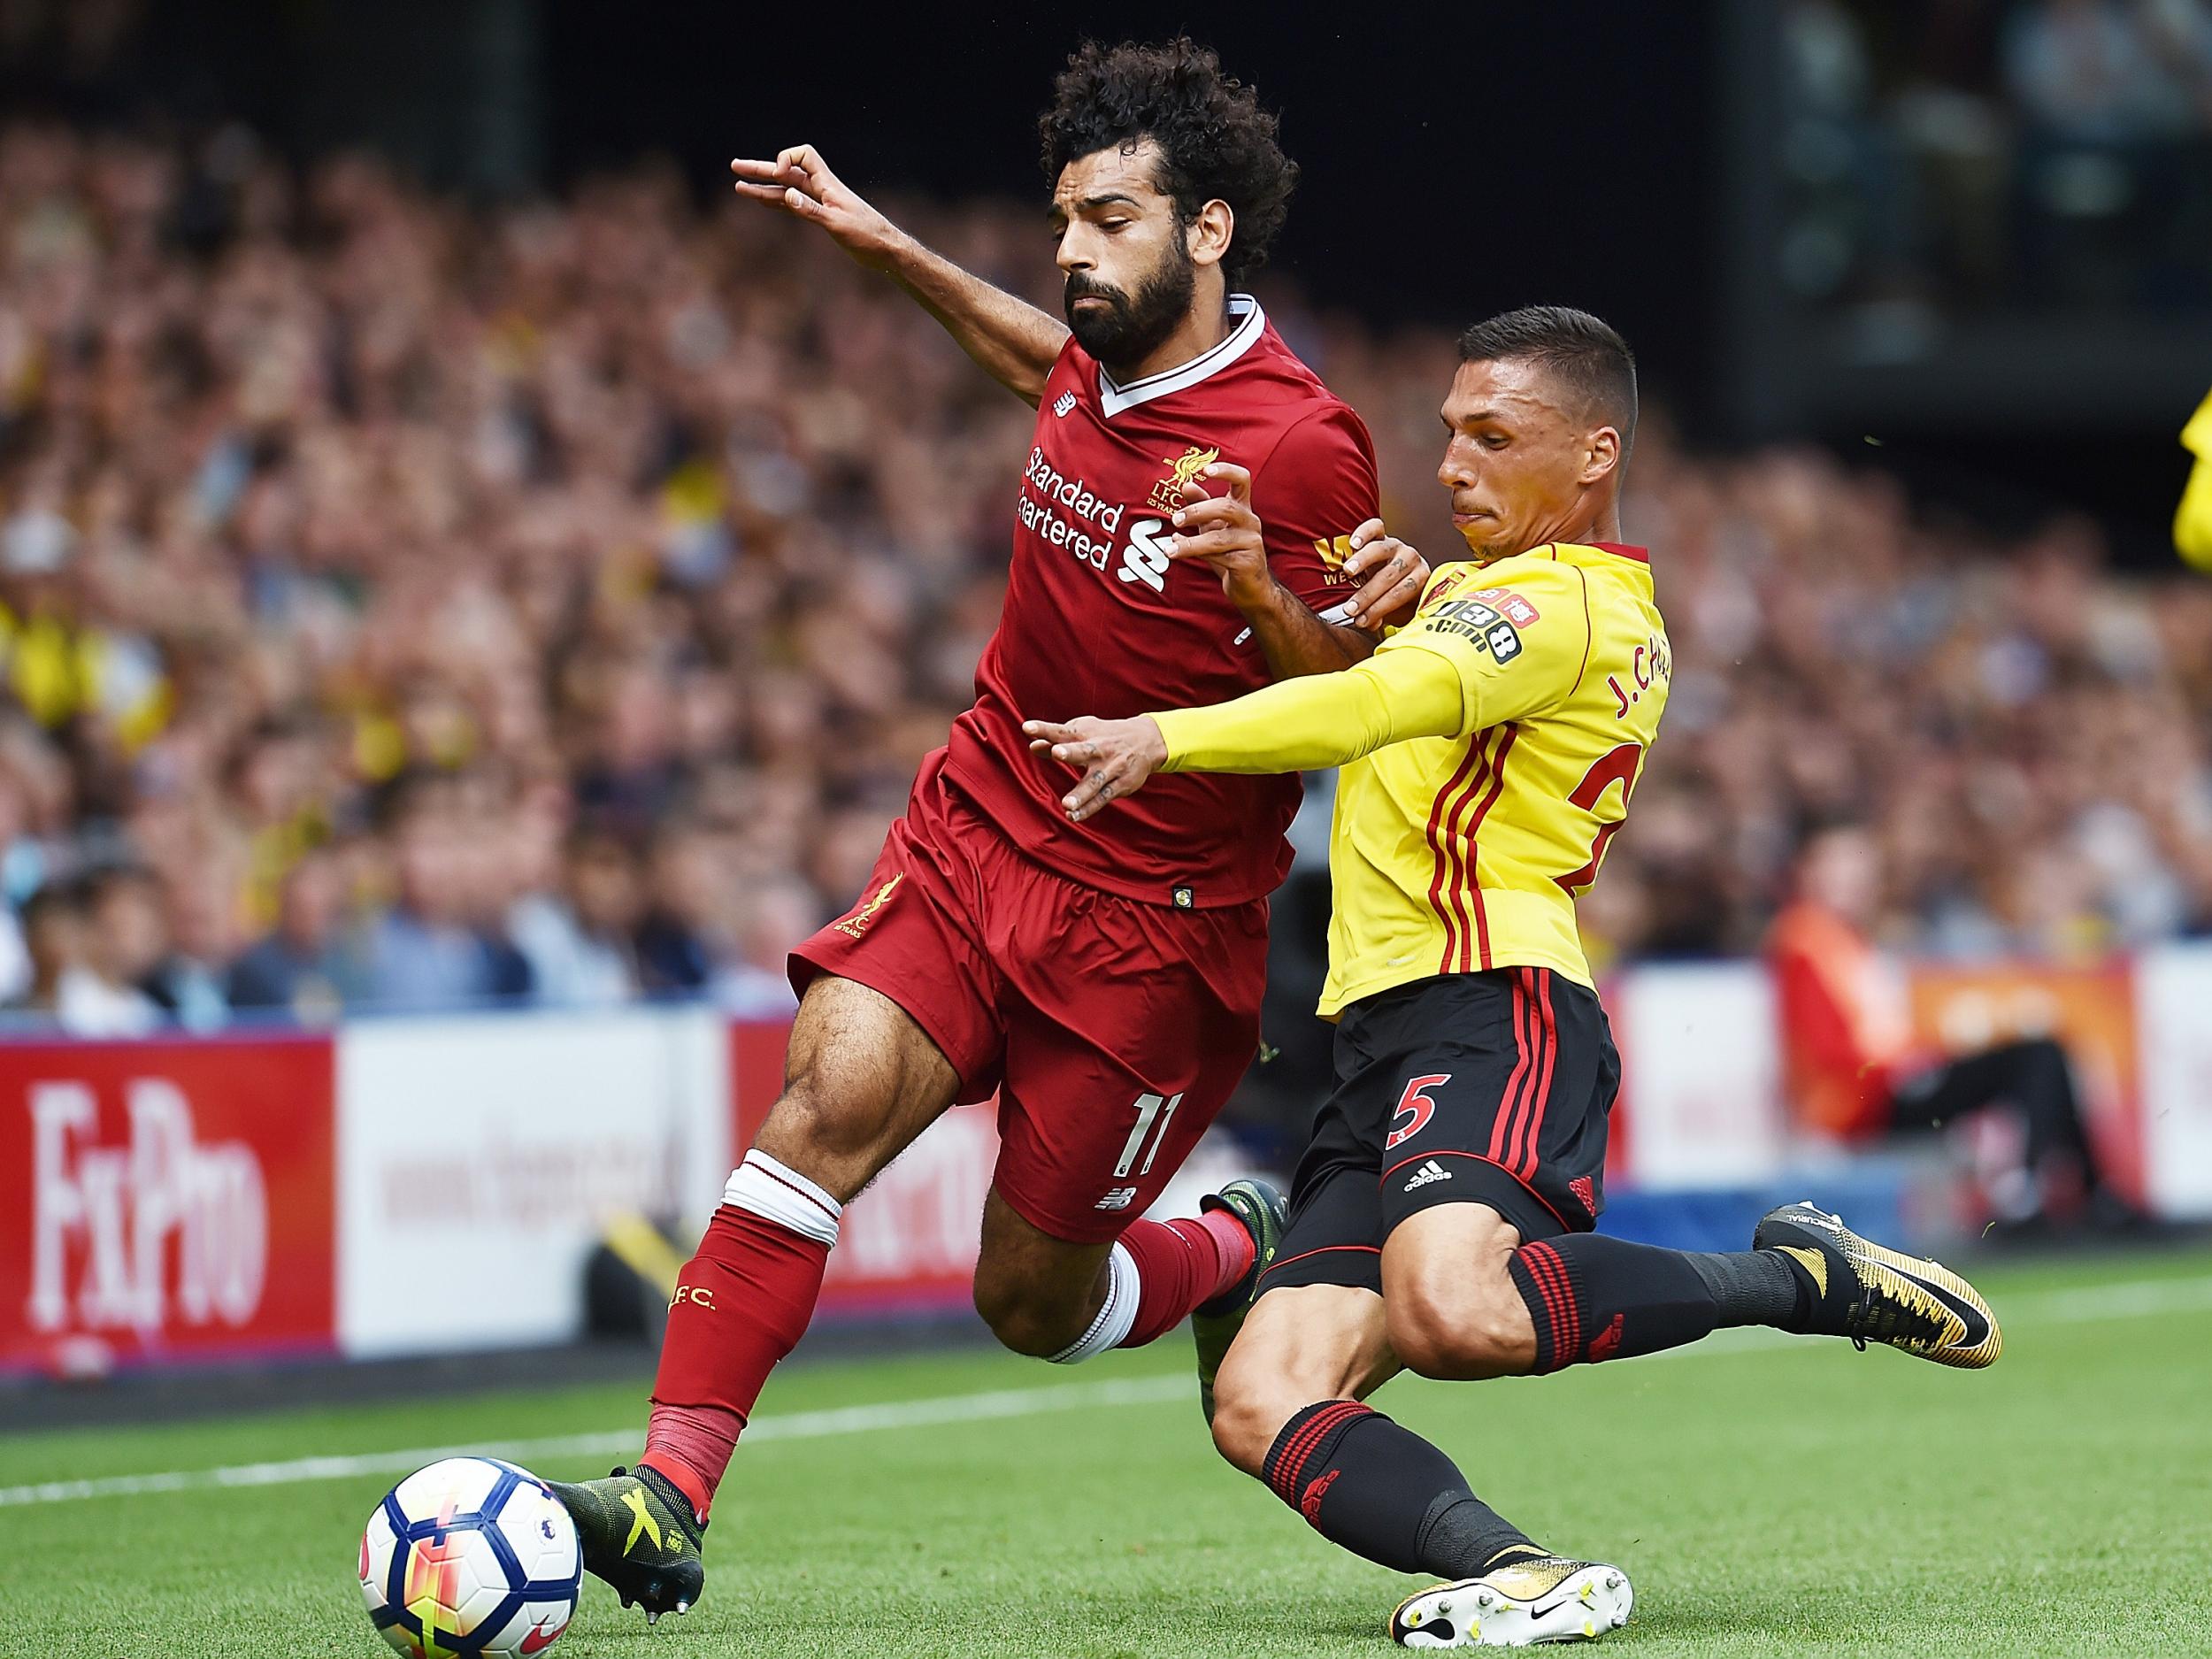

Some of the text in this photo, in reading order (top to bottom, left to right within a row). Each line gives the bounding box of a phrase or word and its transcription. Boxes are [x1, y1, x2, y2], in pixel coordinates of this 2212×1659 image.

[1018, 486, 1112, 572] hartered
[1025, 446, 1125, 534] Standard
[1113, 1092, 1184, 1178] 11
[1386, 1073, 1452, 1151] 5
[27, 1079, 269, 1332] FxPro
[1403, 1171, 1453, 1193] adidas
